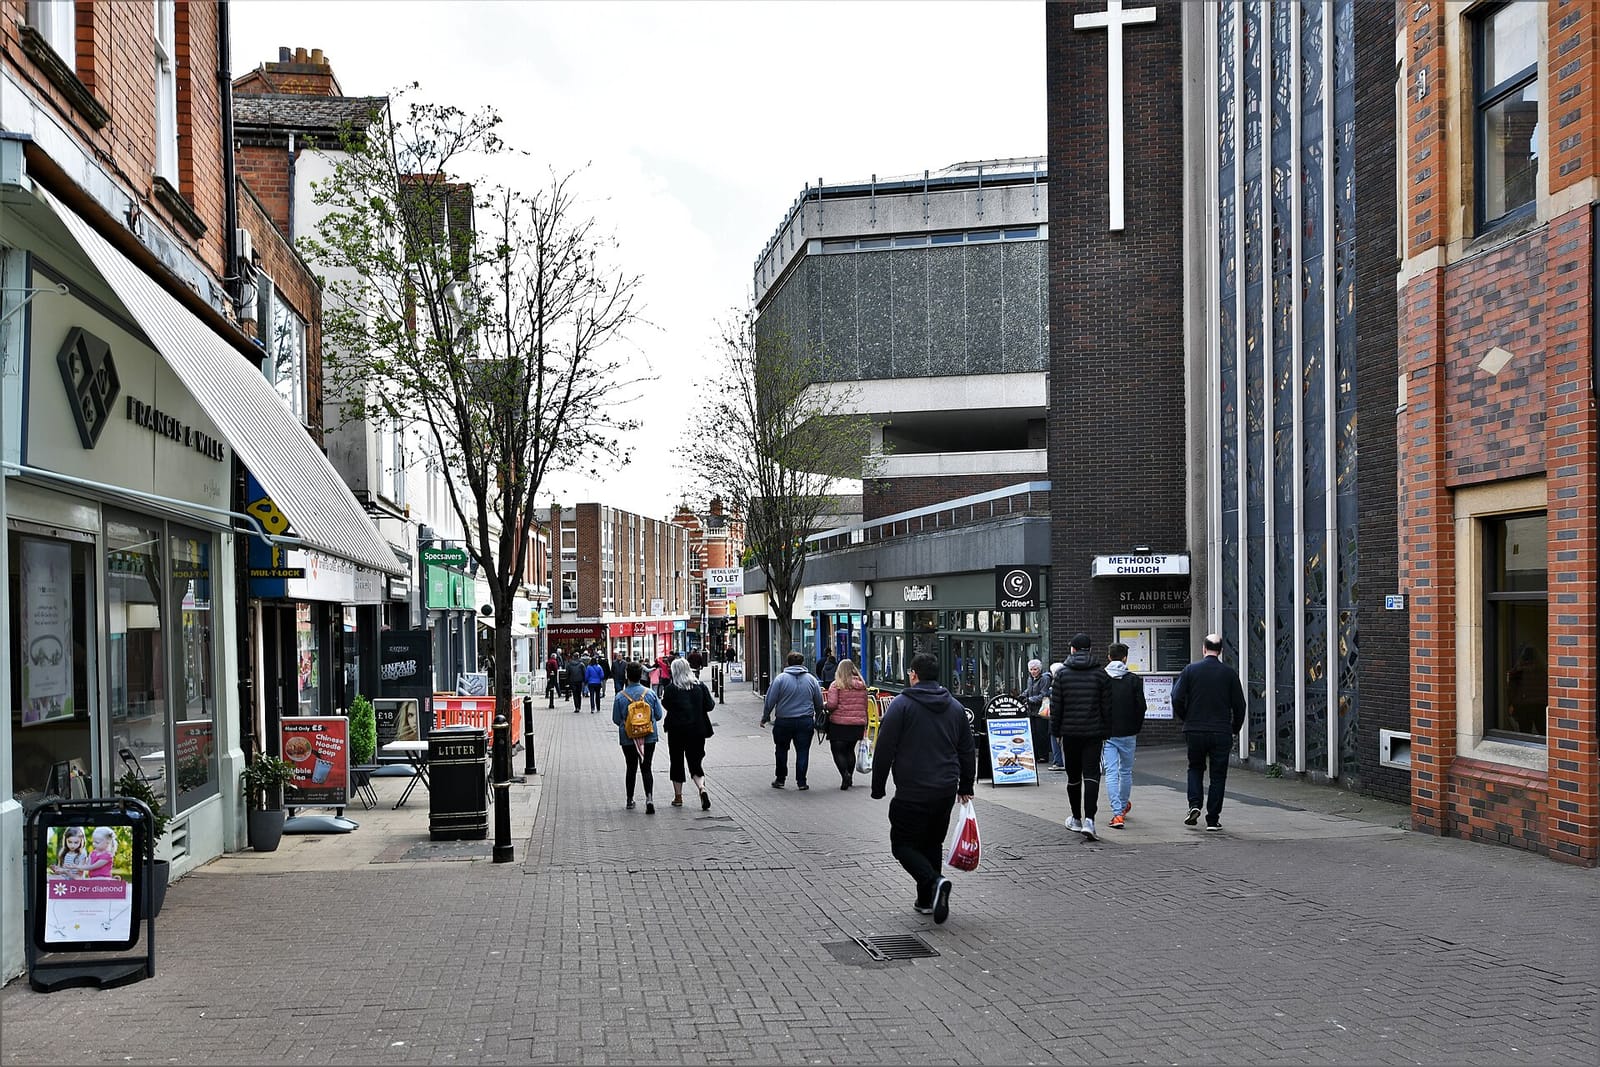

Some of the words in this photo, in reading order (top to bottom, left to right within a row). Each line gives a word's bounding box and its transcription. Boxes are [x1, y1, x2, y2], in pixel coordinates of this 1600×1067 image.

[126, 395, 182, 442] FRANCIS
[184, 426, 193, 447] &
[195, 430, 225, 462] WILLS
[424, 552, 462, 560] Specsavers
[1108, 556, 1167, 564] METHODIST
[1116, 566, 1160, 574] CHURCH
[1119, 591, 1135, 601] ST.
[1139, 590, 1188, 601] ANDREWS
[994, 697, 1026, 713] ANDREWS
[378, 711, 394, 720] £18
[315, 734, 344, 744] Chinese
[315, 740, 342, 751] Noodle
[438, 745, 475, 756] LITTER
[317, 748, 336, 758] Soup
[69, 885, 77, 893] D
[78, 885, 90, 893] for
[91, 885, 123, 893] diamond
